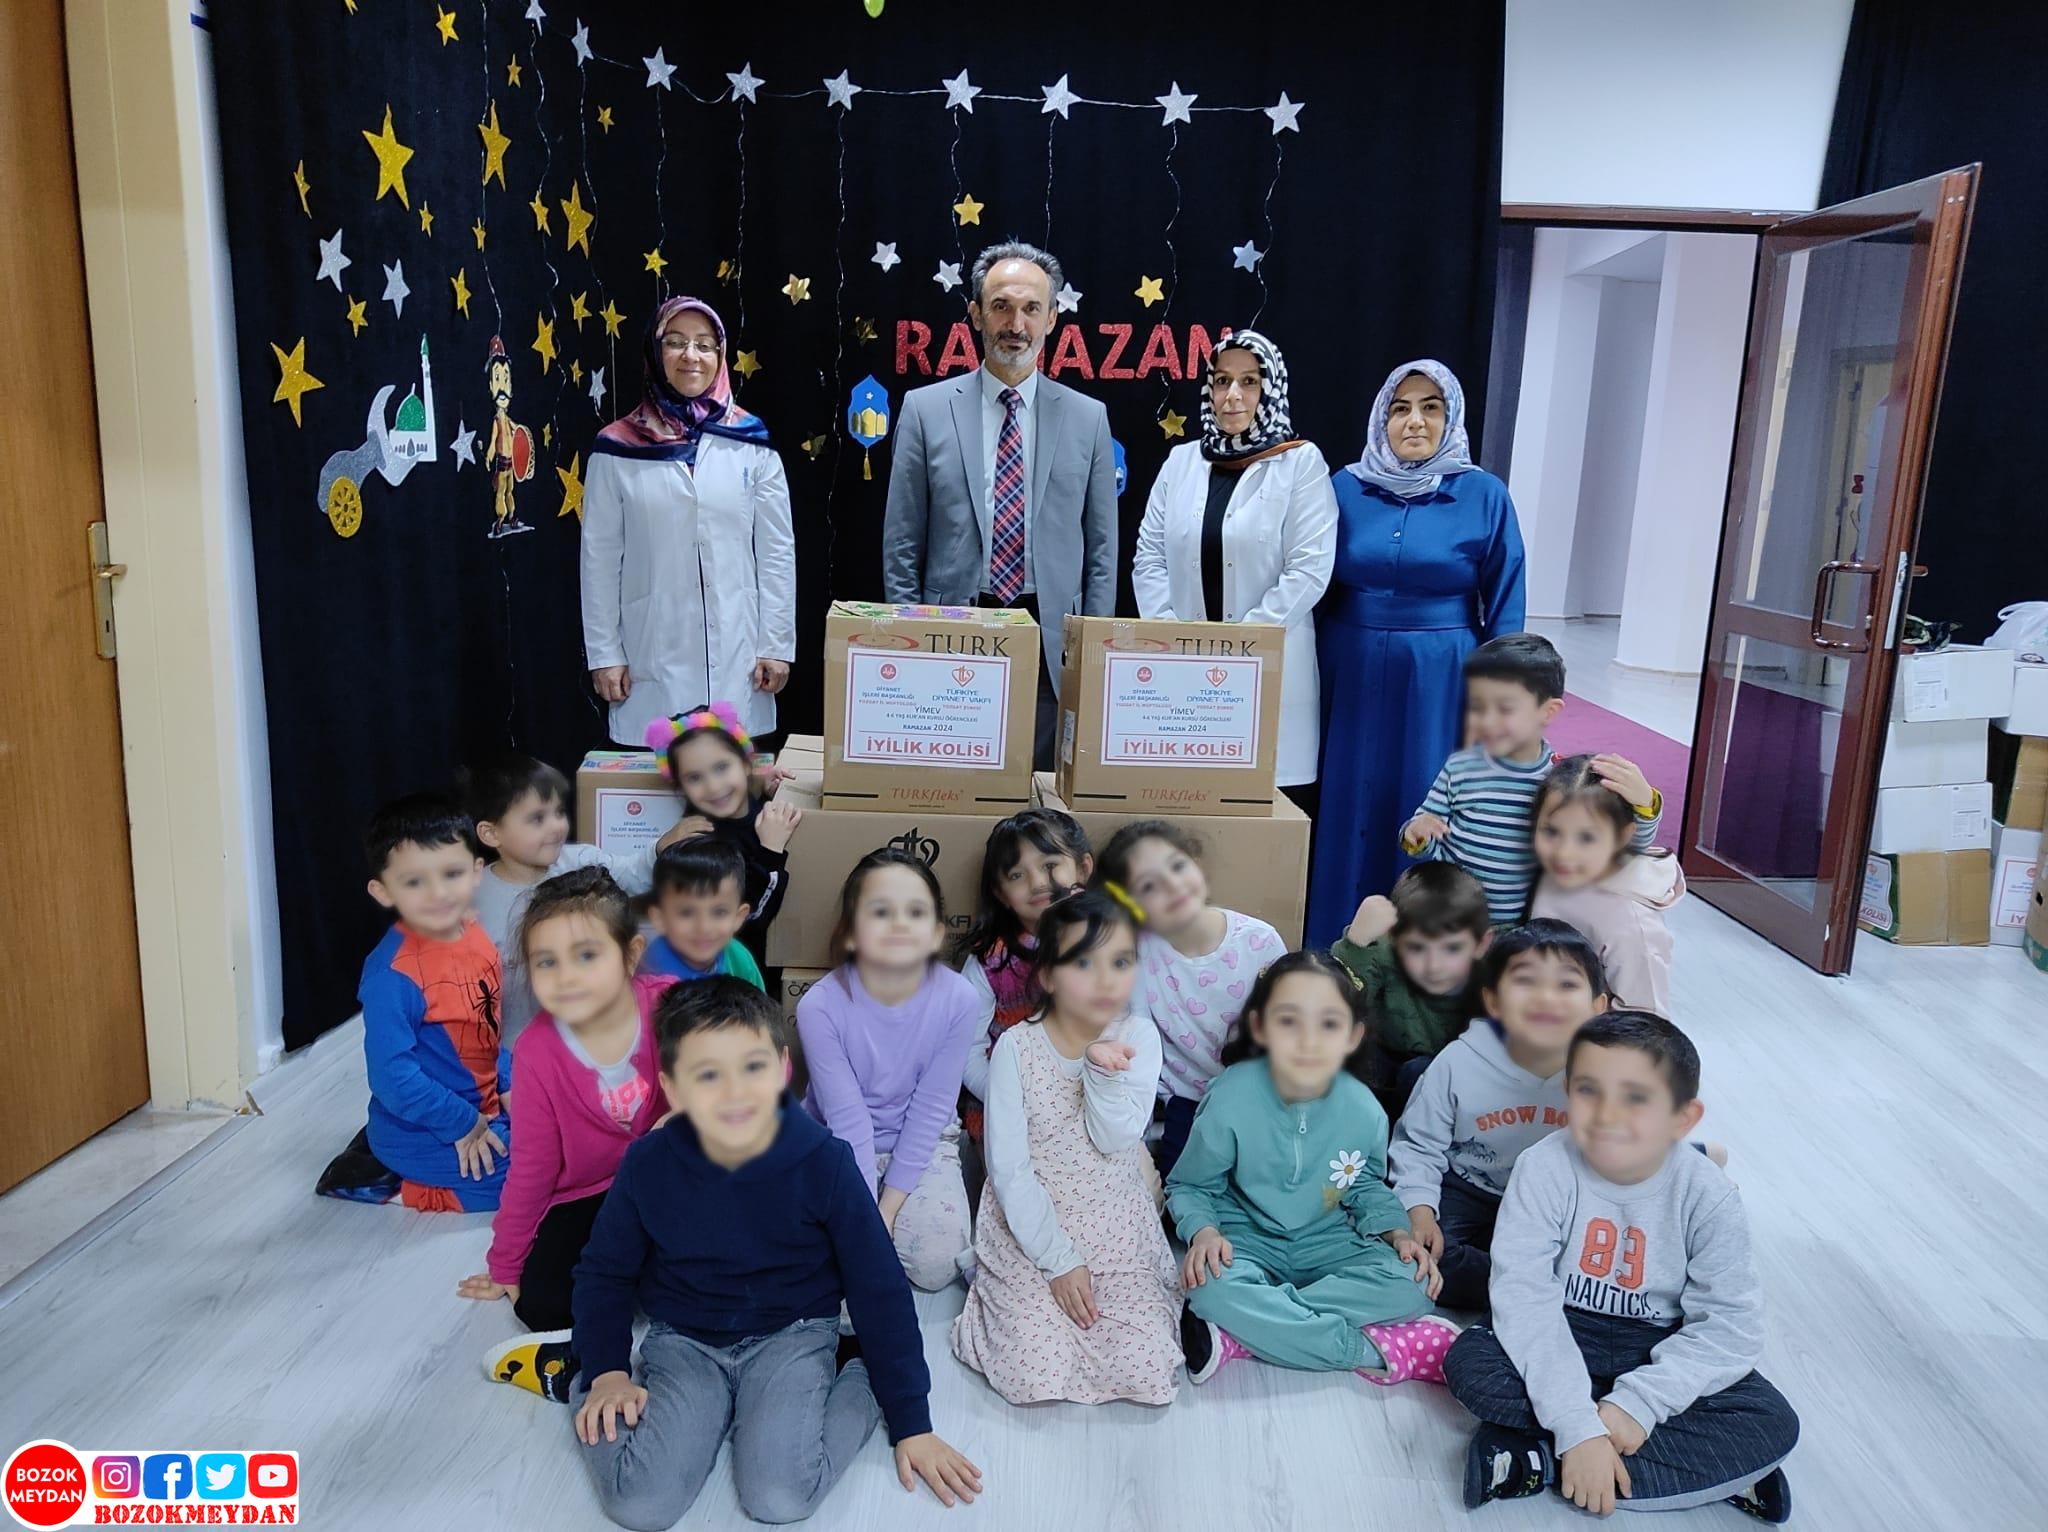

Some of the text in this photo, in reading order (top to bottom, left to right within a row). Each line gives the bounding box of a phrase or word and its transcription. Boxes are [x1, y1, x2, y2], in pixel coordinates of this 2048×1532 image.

[895, 320, 1233, 380] RAAZAN
[925, 633, 1010, 657] TURK
[915, 704, 941, 714] YİMEV
[1170, 706, 1195, 715] YİMEV
[933, 724, 953, 732] 2024
[1187, 724, 1207, 732] 2024
[867, 736, 990, 757] İYİLİK KOLİSİ
[1124, 739, 1243, 756] İYİLİK KOLİSİ
[1476, 1105, 1569, 1132] SNOW BO
[1579, 1216, 1647, 1290] 83
